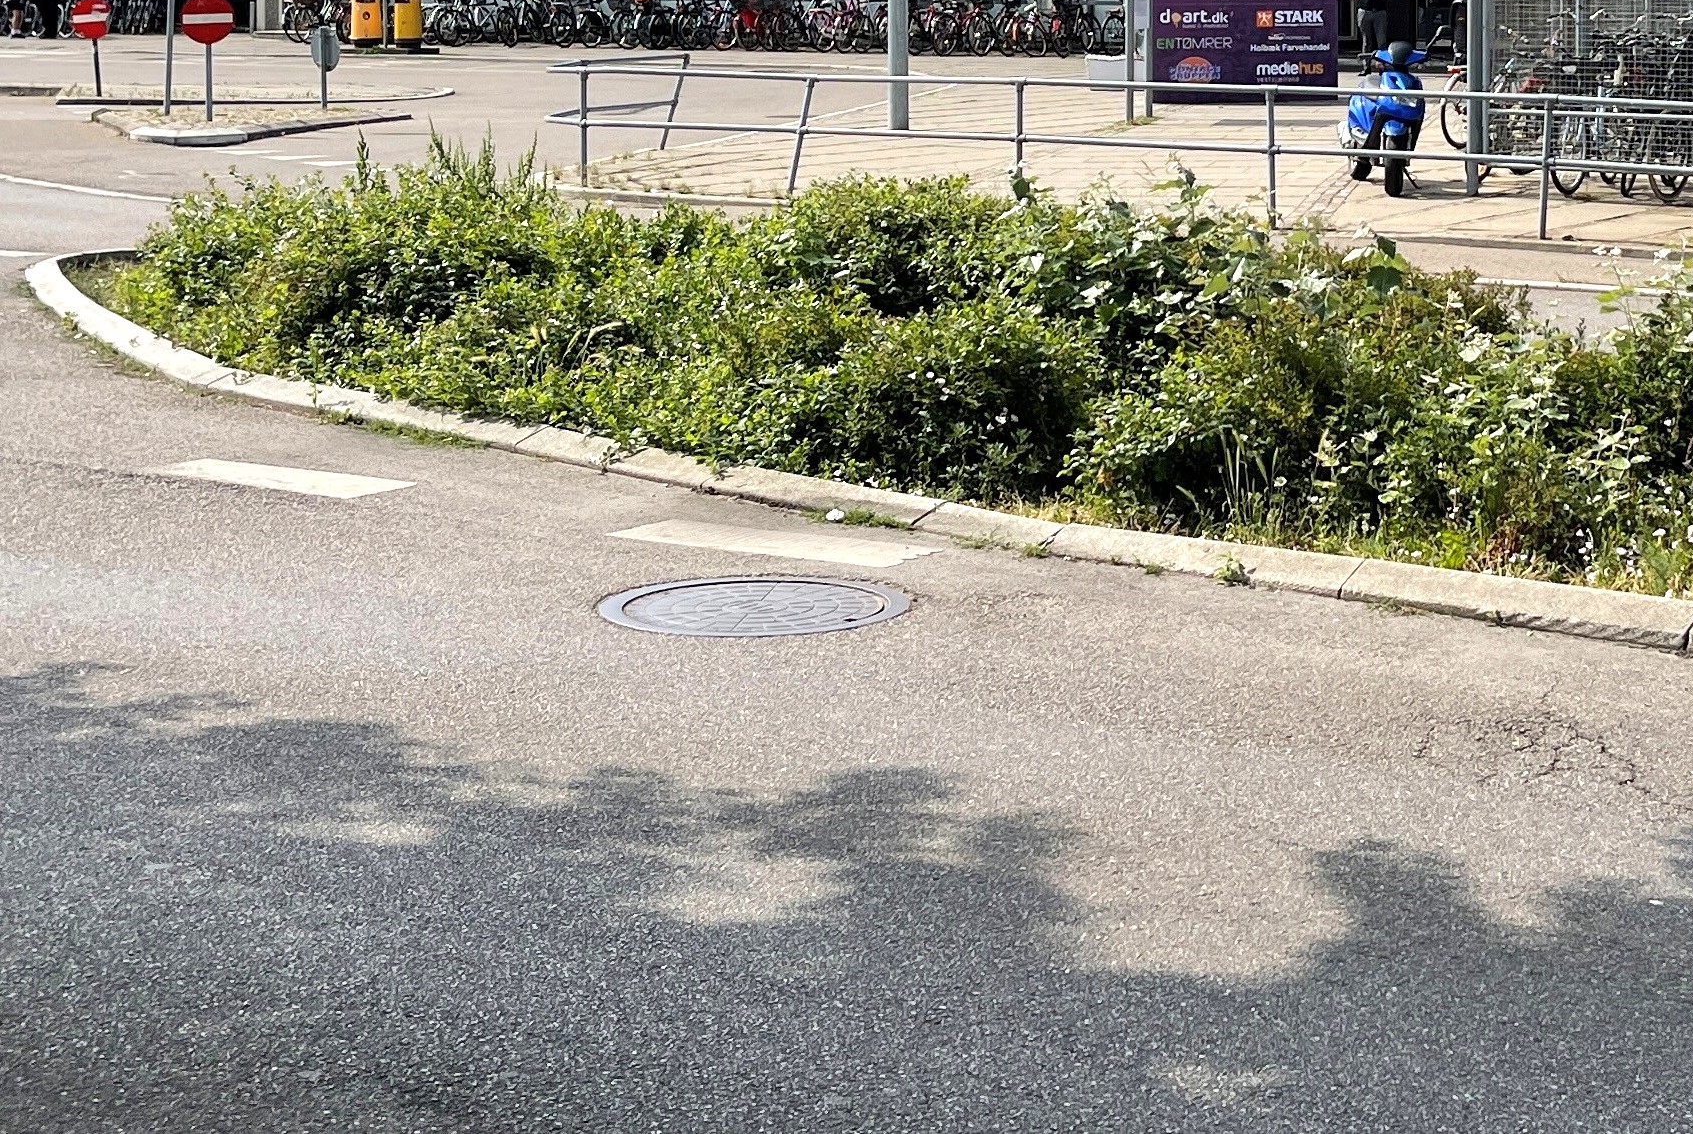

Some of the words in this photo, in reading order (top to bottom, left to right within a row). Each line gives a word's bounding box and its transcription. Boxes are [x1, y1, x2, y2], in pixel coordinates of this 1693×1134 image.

[1274, 9, 1324, 23] STARK
[1250, 43, 1280, 52] Holbæk
[1281, 42, 1330, 52] Farvehandel
[1256, 61, 1324, 76] mediehus
